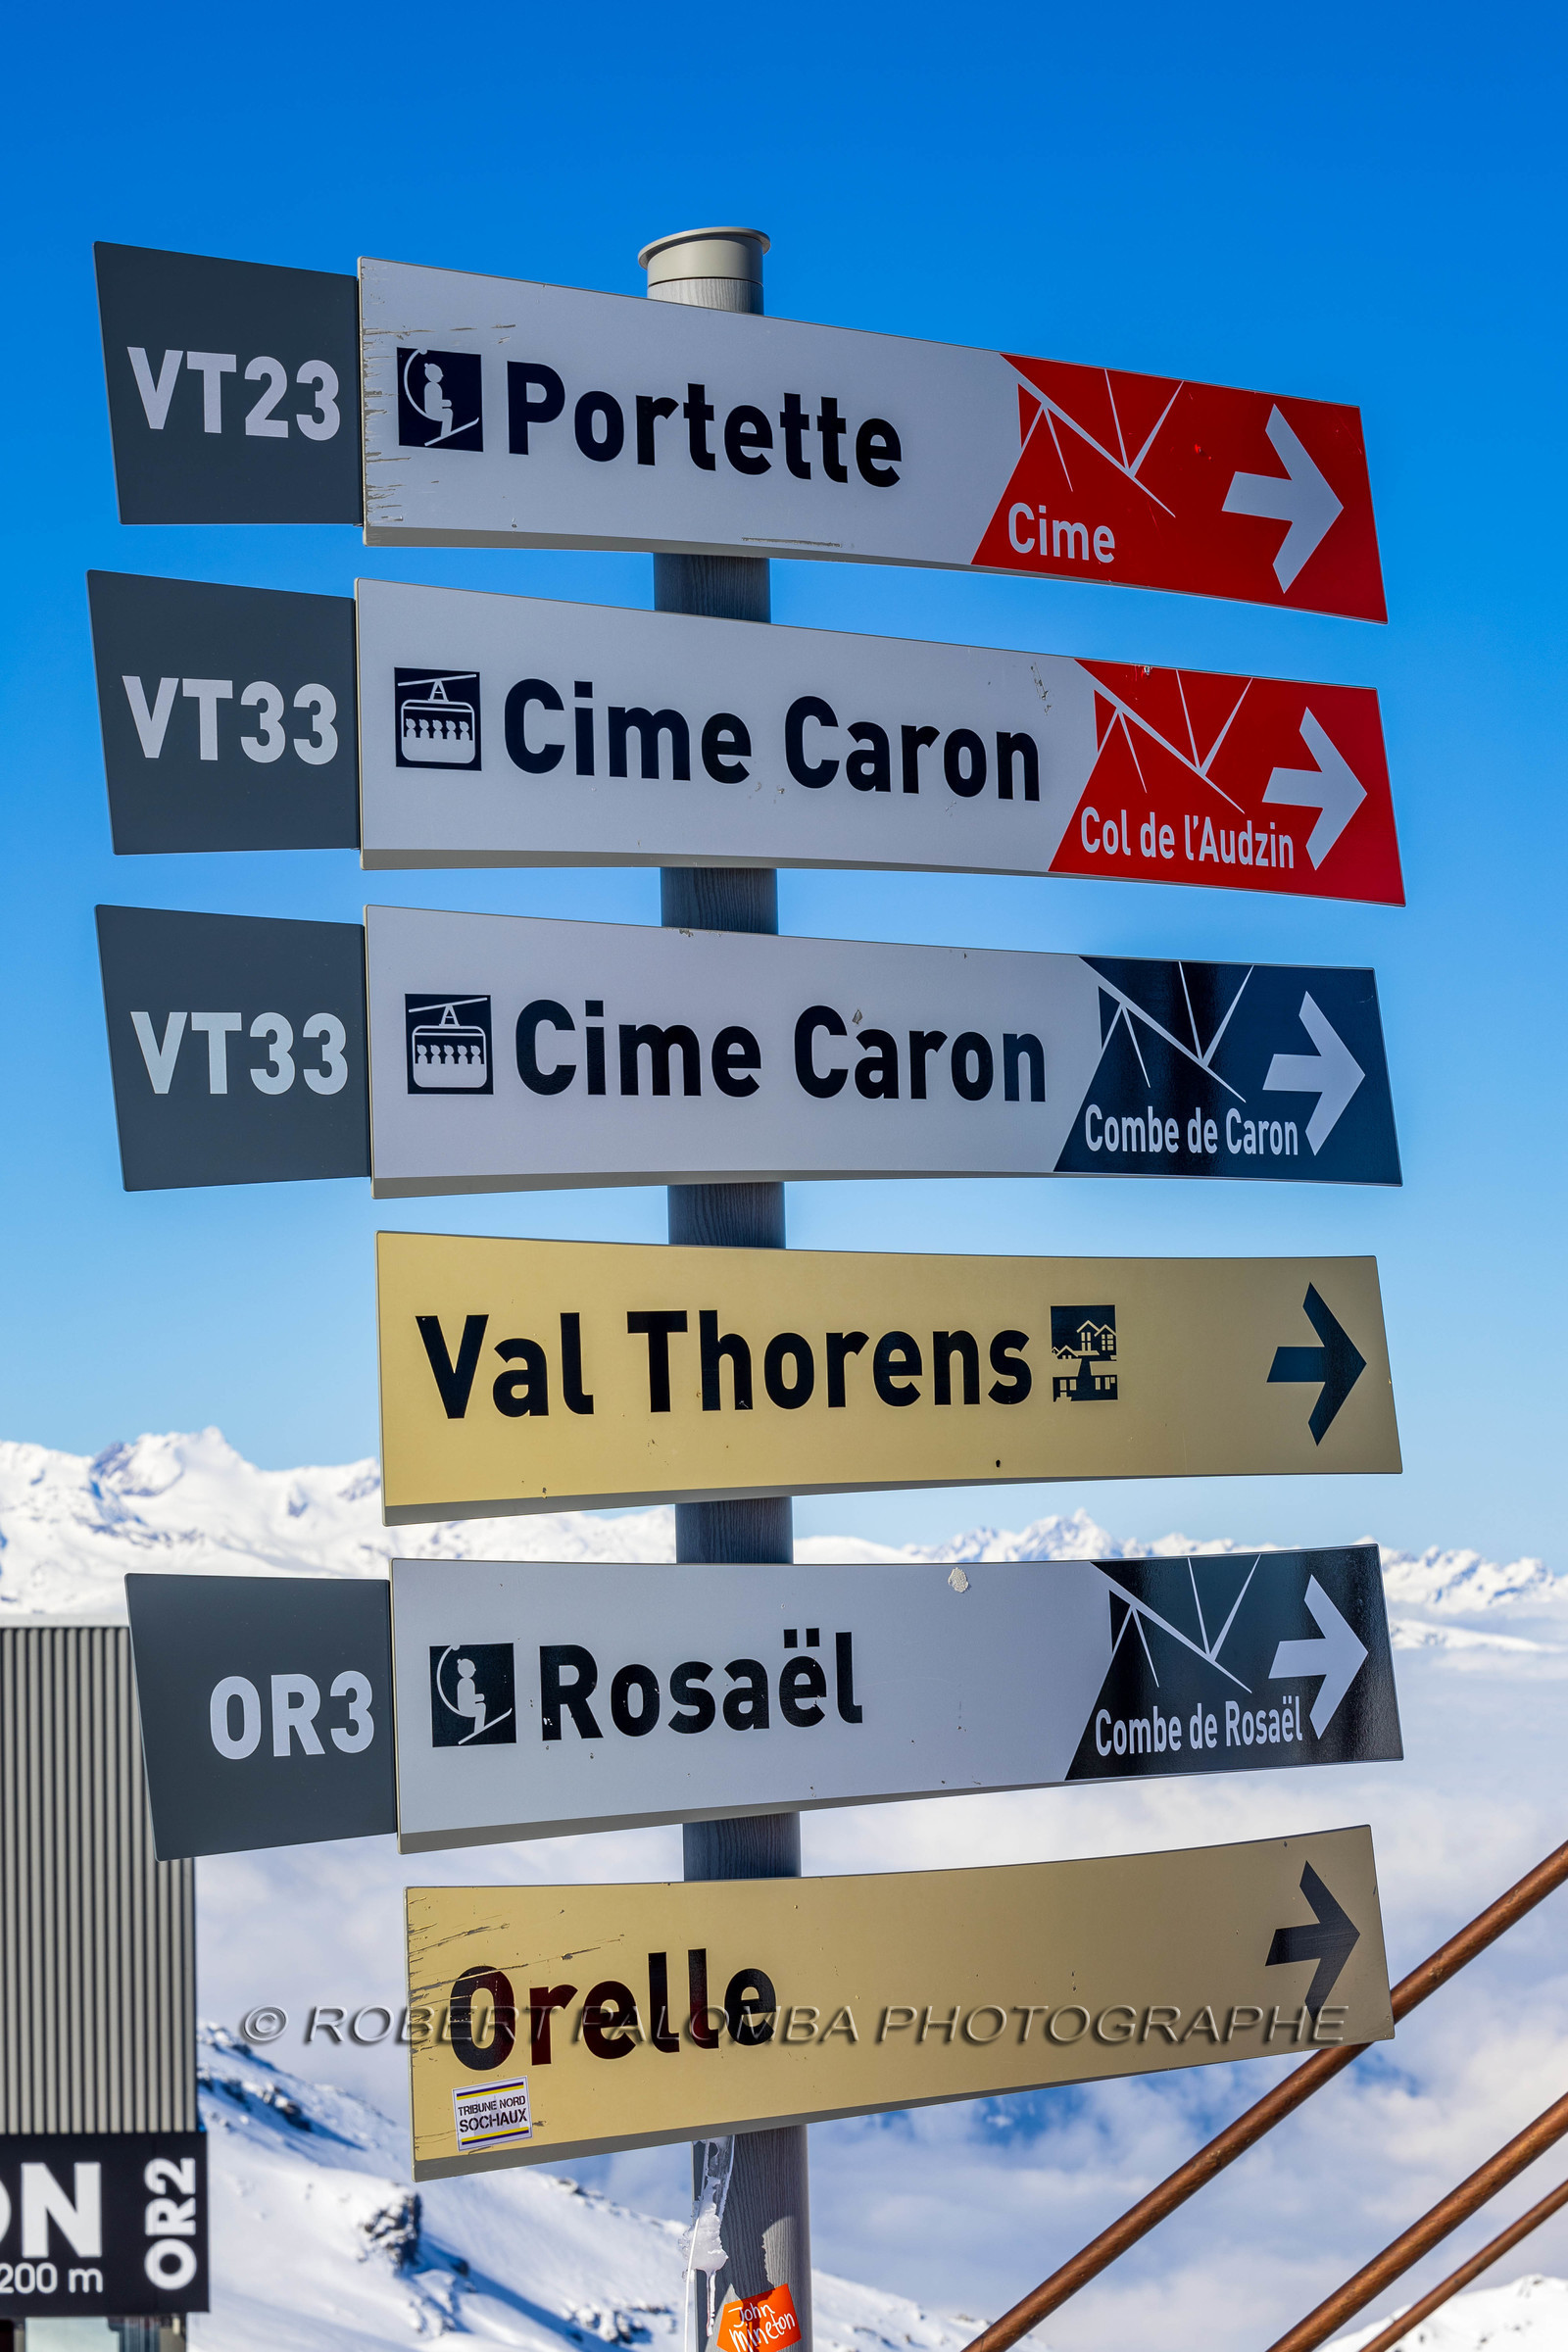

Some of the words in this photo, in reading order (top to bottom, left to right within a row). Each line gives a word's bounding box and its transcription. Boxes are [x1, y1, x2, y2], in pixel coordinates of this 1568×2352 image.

[126, 347, 341, 442] VT23
[507, 360, 903, 489] Portette
[1007, 502, 1116, 564] Cime
[122, 674, 339, 765] VT33
[504, 677, 753, 785] Cime
[784, 695, 1042, 803] Caron
[1080, 807, 1132, 857] Col
[1139, 810, 1176, 860] de
[1184, 814, 1296, 869] l'Audzin
[129, 1010, 349, 1096] VT33
[514, 998, 762, 1099] Cime
[793, 1004, 1047, 1103] Caron
[1084, 1102, 1179, 1153] Combe
[1187, 1107, 1219, 1155] de
[1225, 1107, 1298, 1156] Caron
[414, 1311, 594, 1419] Val
[626, 1308, 1034, 1413] Thorens
[209, 1670, 375, 1761] OR3
[538, 1627, 863, 1741] Rosaël
[1095, 1705, 1183, 1757] Combe
[1189, 1701, 1218, 1750] de
[1225, 1694, 1303, 1747] Rosaël
[449, 1947, 778, 2072] Orelle
[458, 2100, 498, 2117] TRIBUNE
[499, 2095, 526, 2109] NORD
[459, 2108, 528, 2133] SOCHAUX
[144, 2157, 197, 2291] OR2
[68, 2267, 104, 2294] m
[728, 2302, 776, 2328] John
